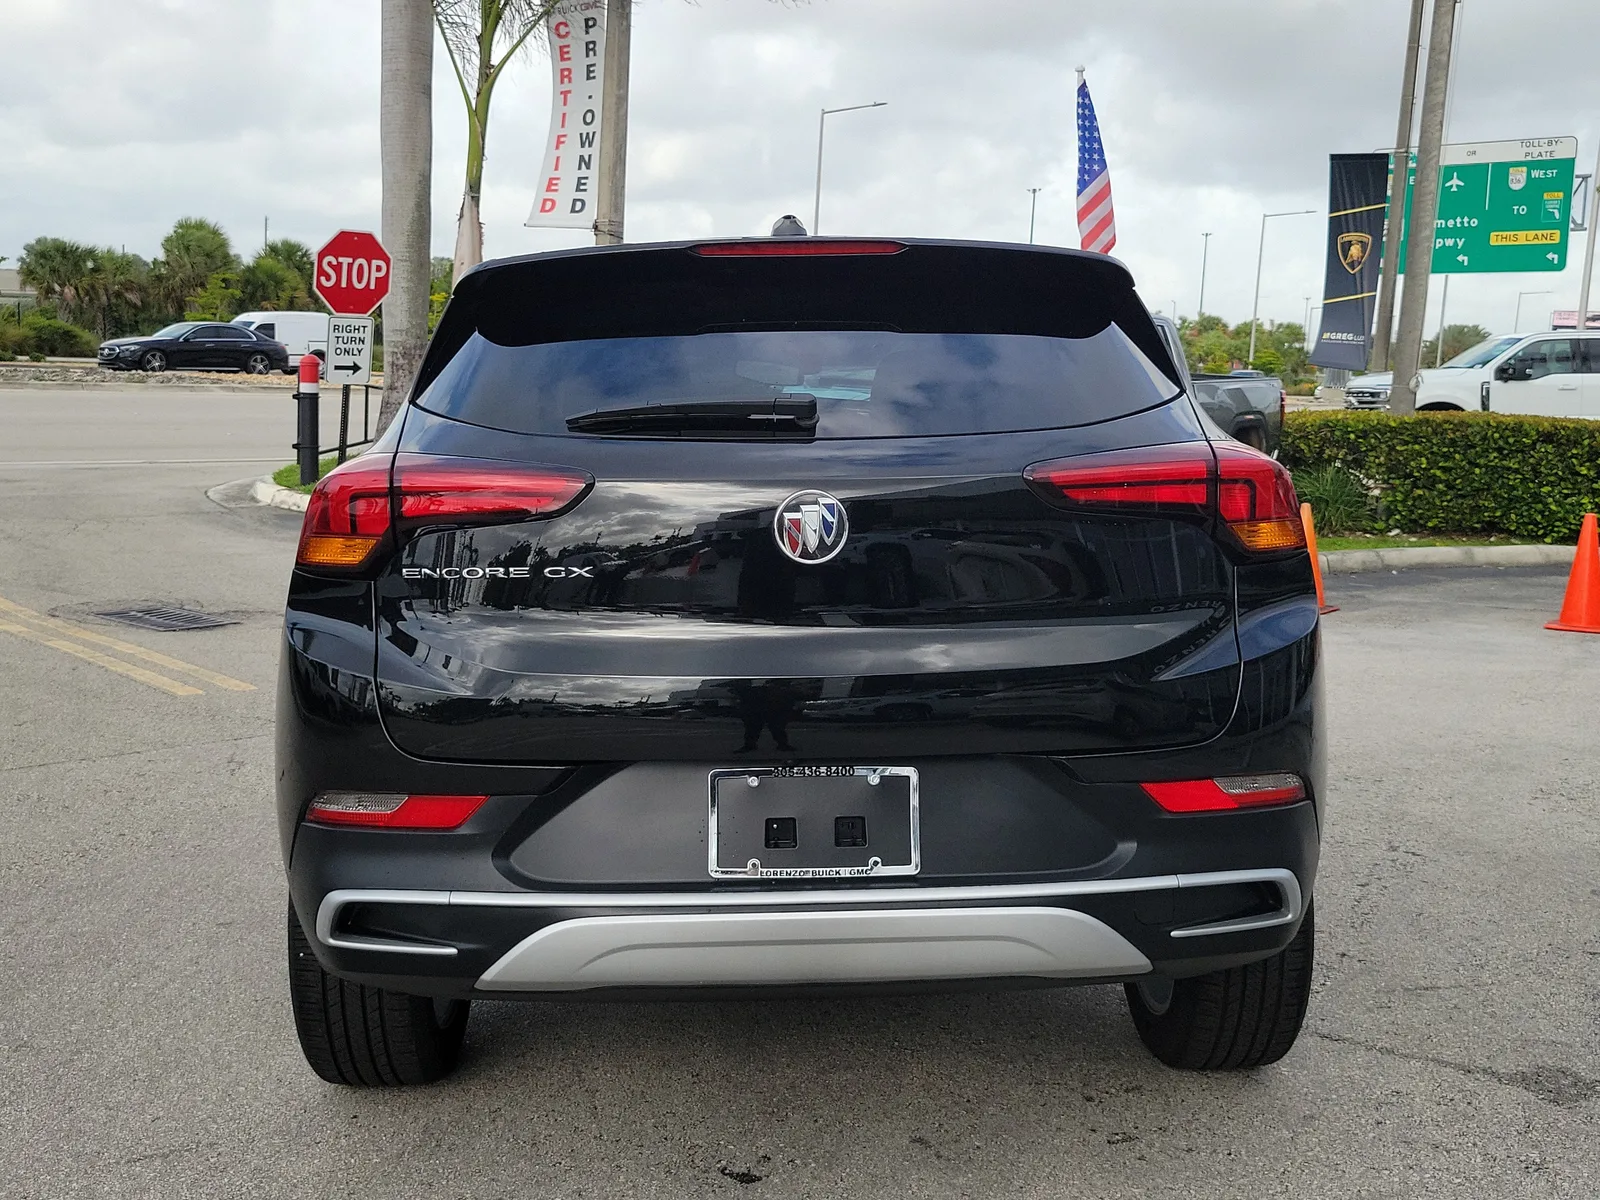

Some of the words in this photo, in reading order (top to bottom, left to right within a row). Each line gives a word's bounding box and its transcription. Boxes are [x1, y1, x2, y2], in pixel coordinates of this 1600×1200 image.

[540, 21, 573, 214] CERTIFIED
[1524, 150, 1555, 159] PLATE
[1530, 169, 1558, 179] WEST
[1512, 205, 1527, 215] TO
[1434, 216, 1479, 229] metto
[1494, 234, 1519, 243] THIS
[1525, 232, 1556, 242] LANE
[1435, 236, 1465, 250] pwy
[319, 256, 387, 289] STOP
[333, 324, 368, 334] RIGHT
[334, 336, 366, 346] TURN
[334, 347, 364, 357] ONLY
[402, 566, 531, 579] ENCORE
[543, 566, 595, 579] GX
[772, 766, 855, 777] 305-436-8400
[760, 869, 805, 877] LORENZO
[811, 868, 841, 877] BUICK
[849, 867, 871, 876] GMC
